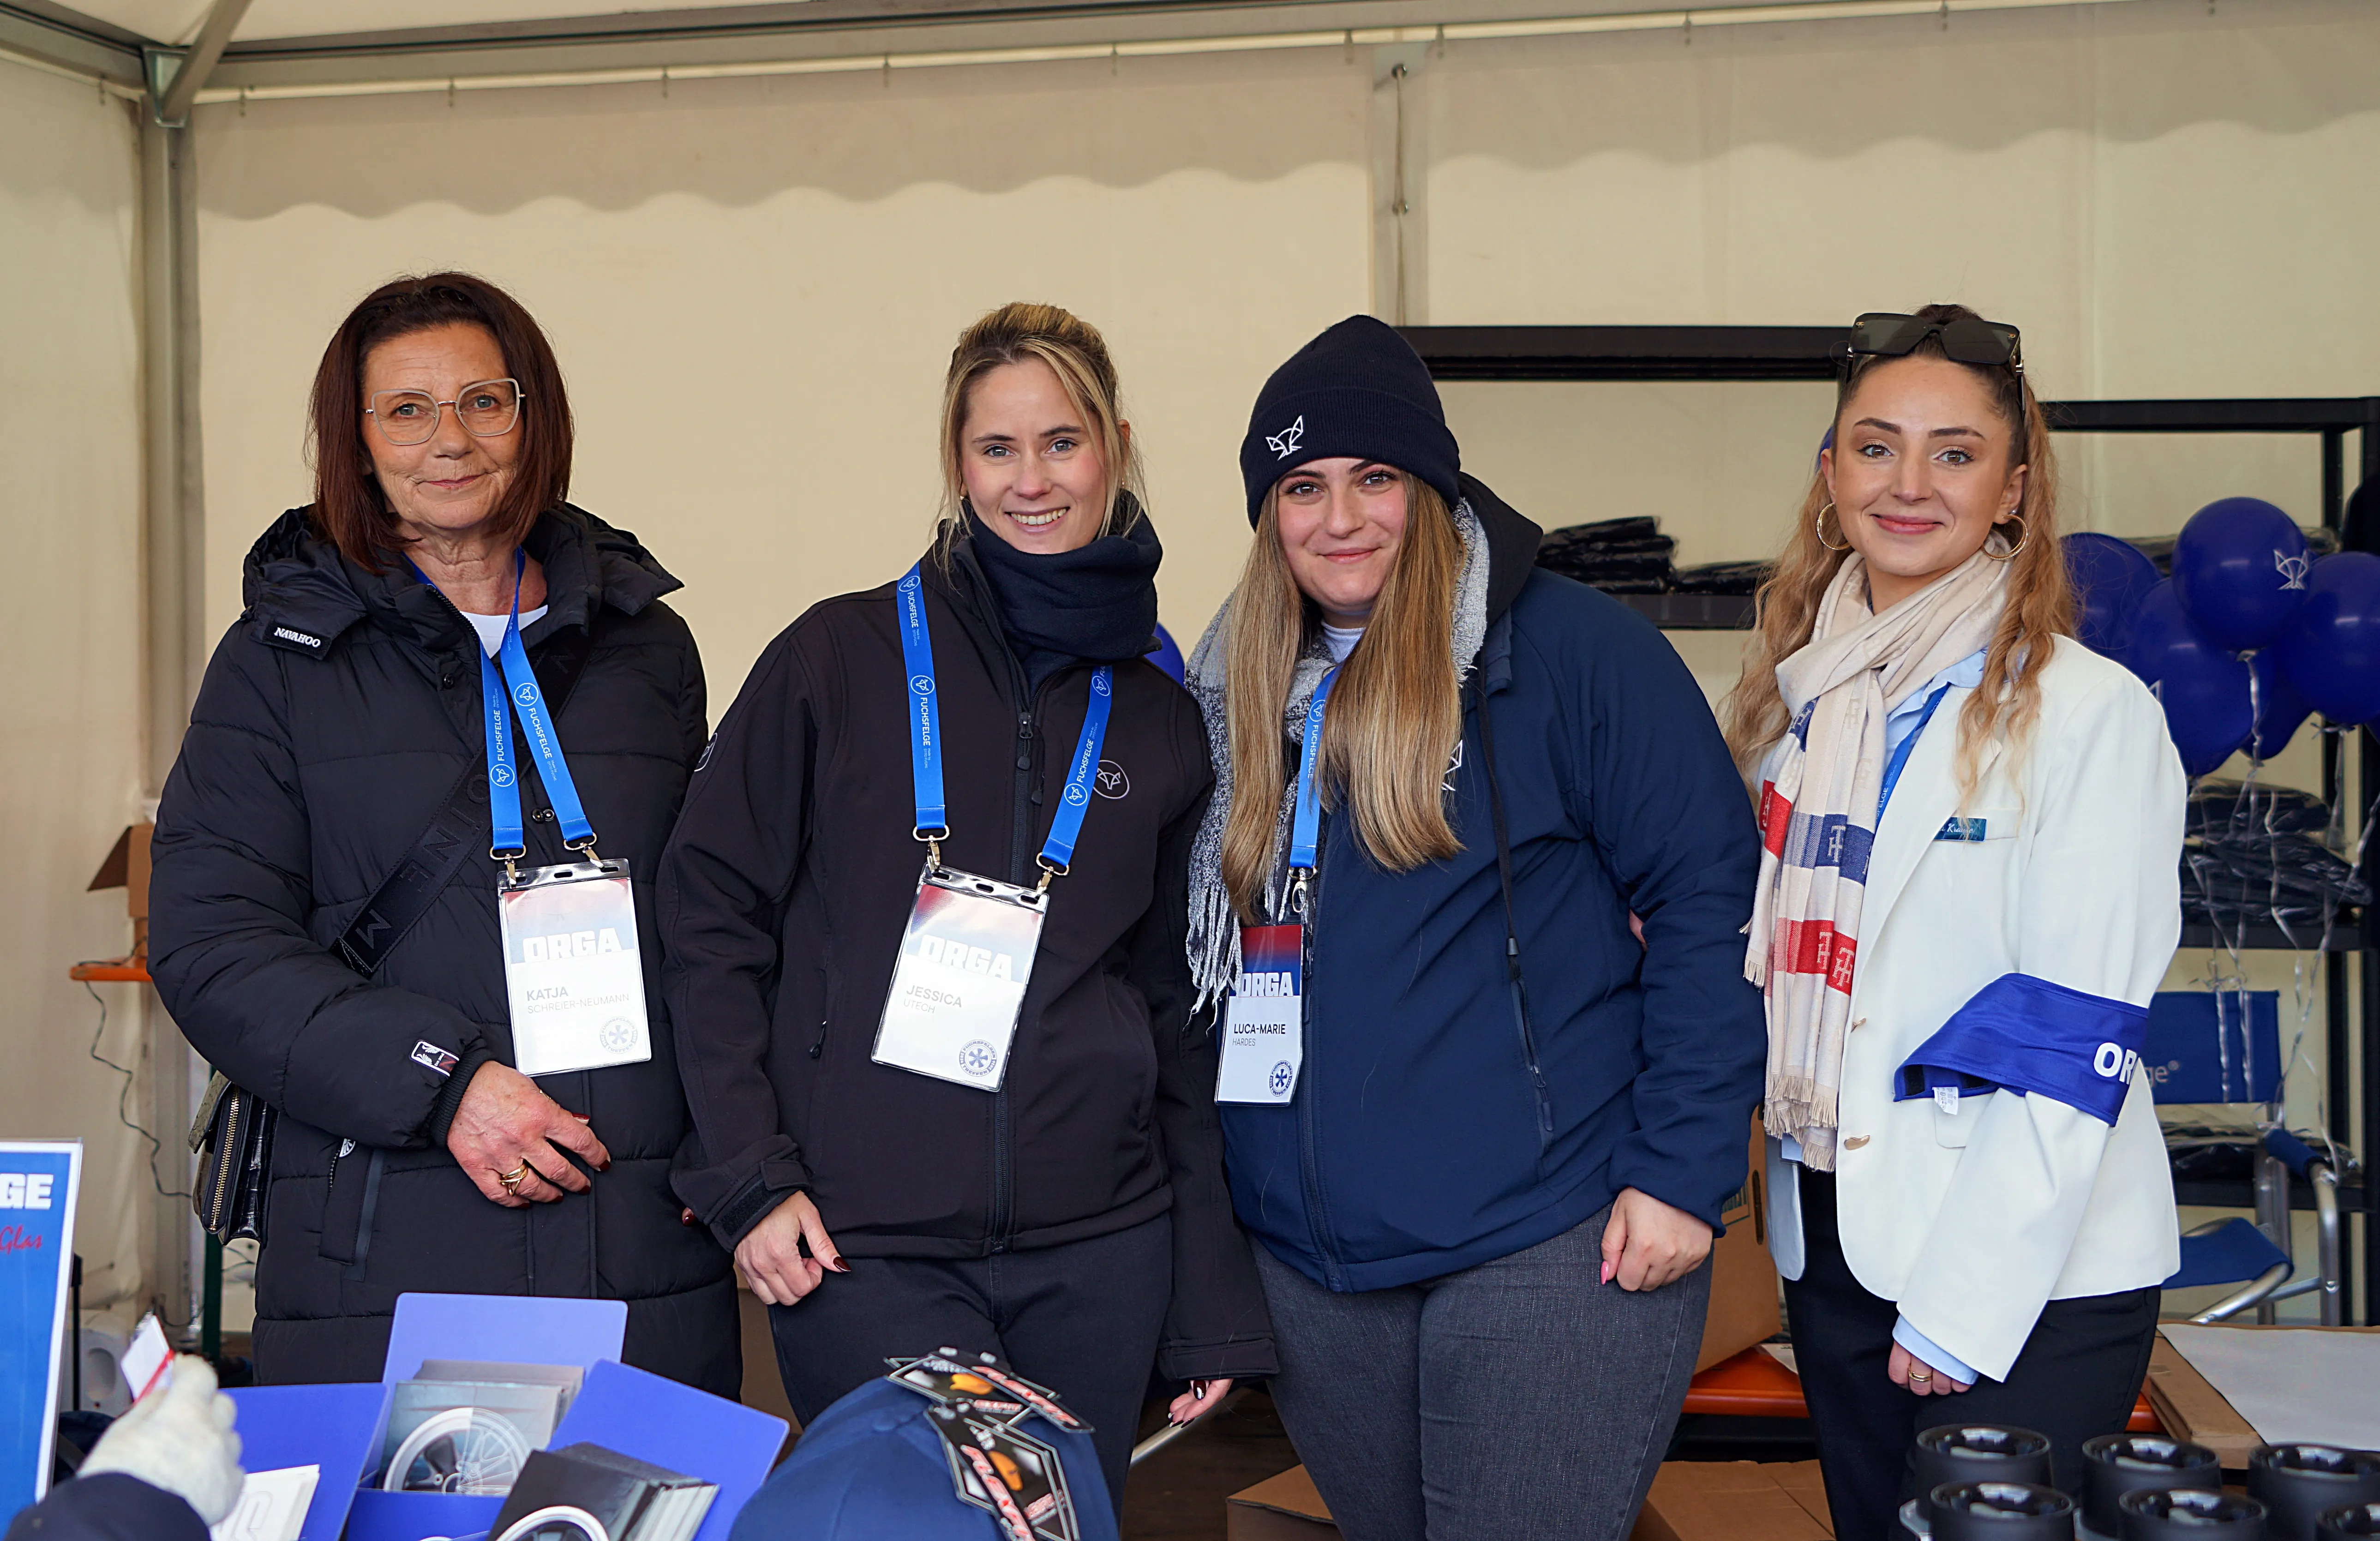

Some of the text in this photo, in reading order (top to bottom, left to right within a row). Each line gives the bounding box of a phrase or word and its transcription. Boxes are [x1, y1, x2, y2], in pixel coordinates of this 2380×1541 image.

[907, 591, 918, 628] FUCHSFELGE
[274, 627, 321, 648] NAVAHOO
[528, 707, 552, 759] FUCHSFELGE
[921, 697, 930, 746] FUCHSFELGE
[494, 710, 504, 761] FUCHSFELGE
[1076, 738, 1094, 783] FUCHSFELGE
[522, 928, 623, 963] ORGA
[919, 934, 1012, 981] ORGA
[527, 986, 569, 1001] KATJA
[906, 985, 962, 1008] JESSICA
[1238, 972, 1294, 997] ORGA
[528, 993, 629, 1014] SCHREIER-NEUMANN
[903, 998, 936, 1014] UTECH
[1232, 1038, 1256, 1046] HARDES
[1233, 1023, 1286, 1035] LUCA-MARIE
[0, 1225, 43, 1255] Glas
